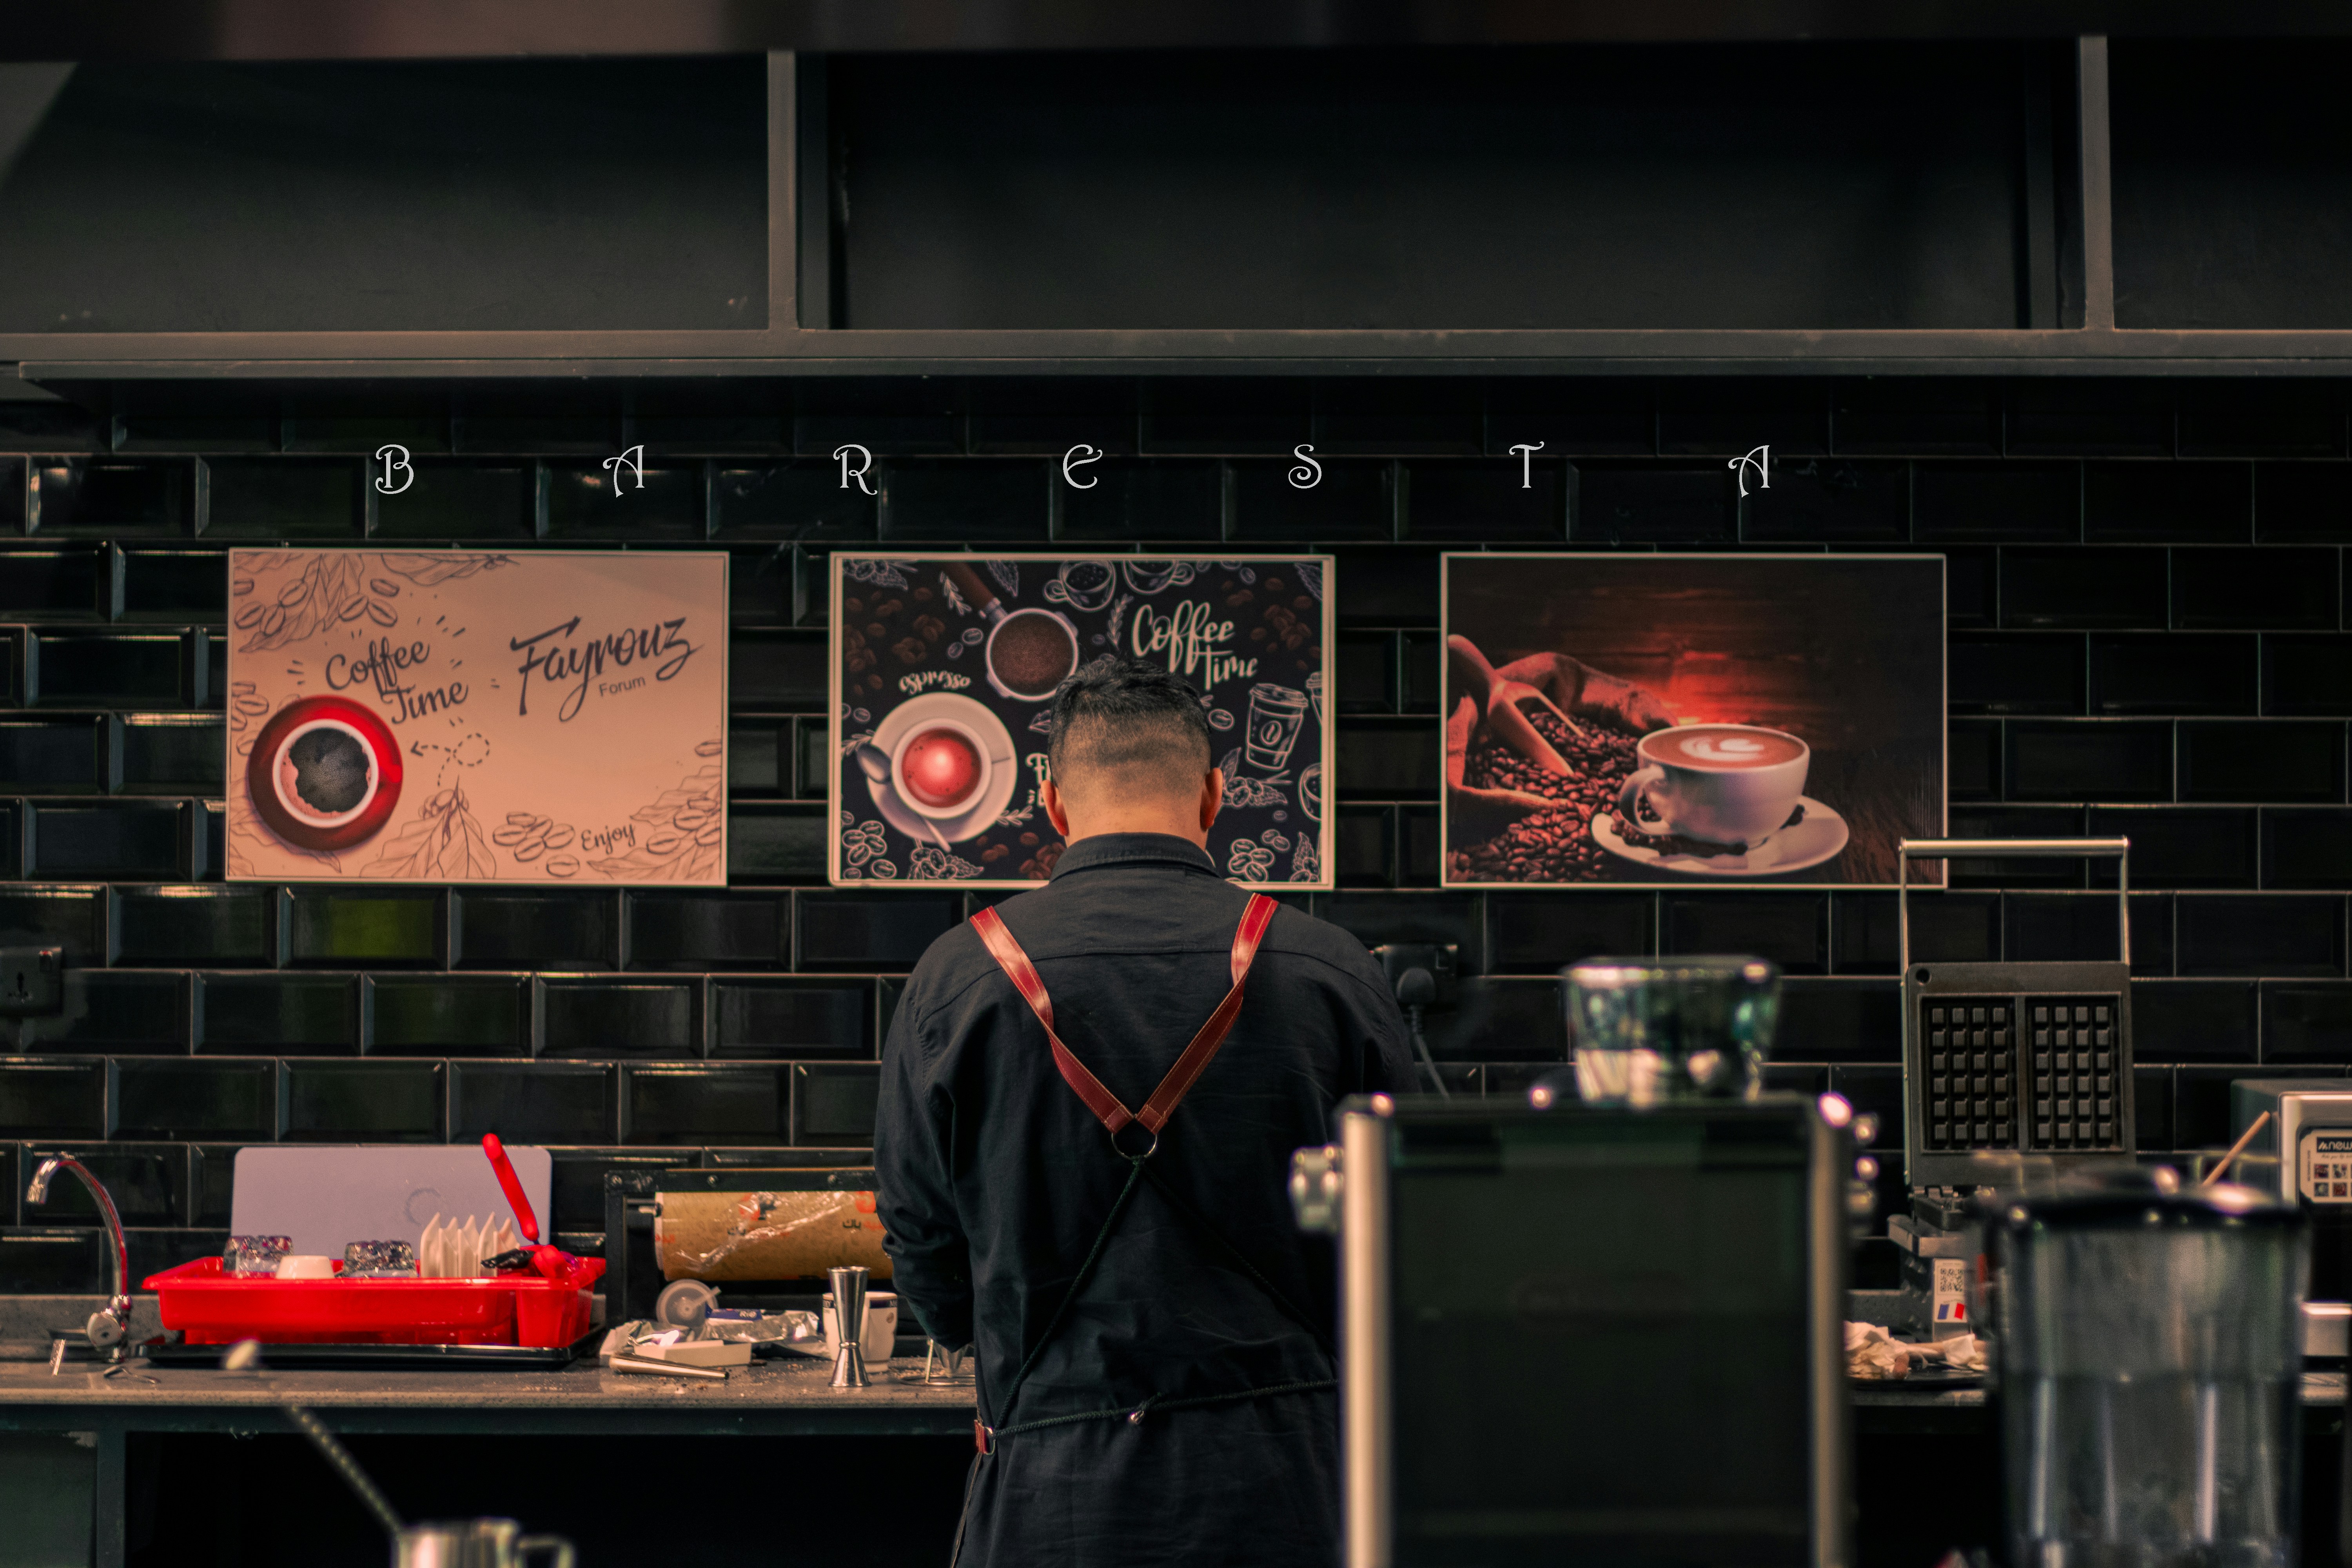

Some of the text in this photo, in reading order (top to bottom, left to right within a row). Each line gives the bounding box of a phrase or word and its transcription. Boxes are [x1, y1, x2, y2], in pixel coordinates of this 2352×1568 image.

[1132, 600, 1234, 674] Coffee
[325, 636, 430, 698] Coffee
[510, 616, 703, 722] Fayrouz
[598, 677, 646, 697] Forum
[899, 670, 971, 695] espresso
[382, 681, 468, 724] Time
[581, 824, 635, 854] Enjoy
